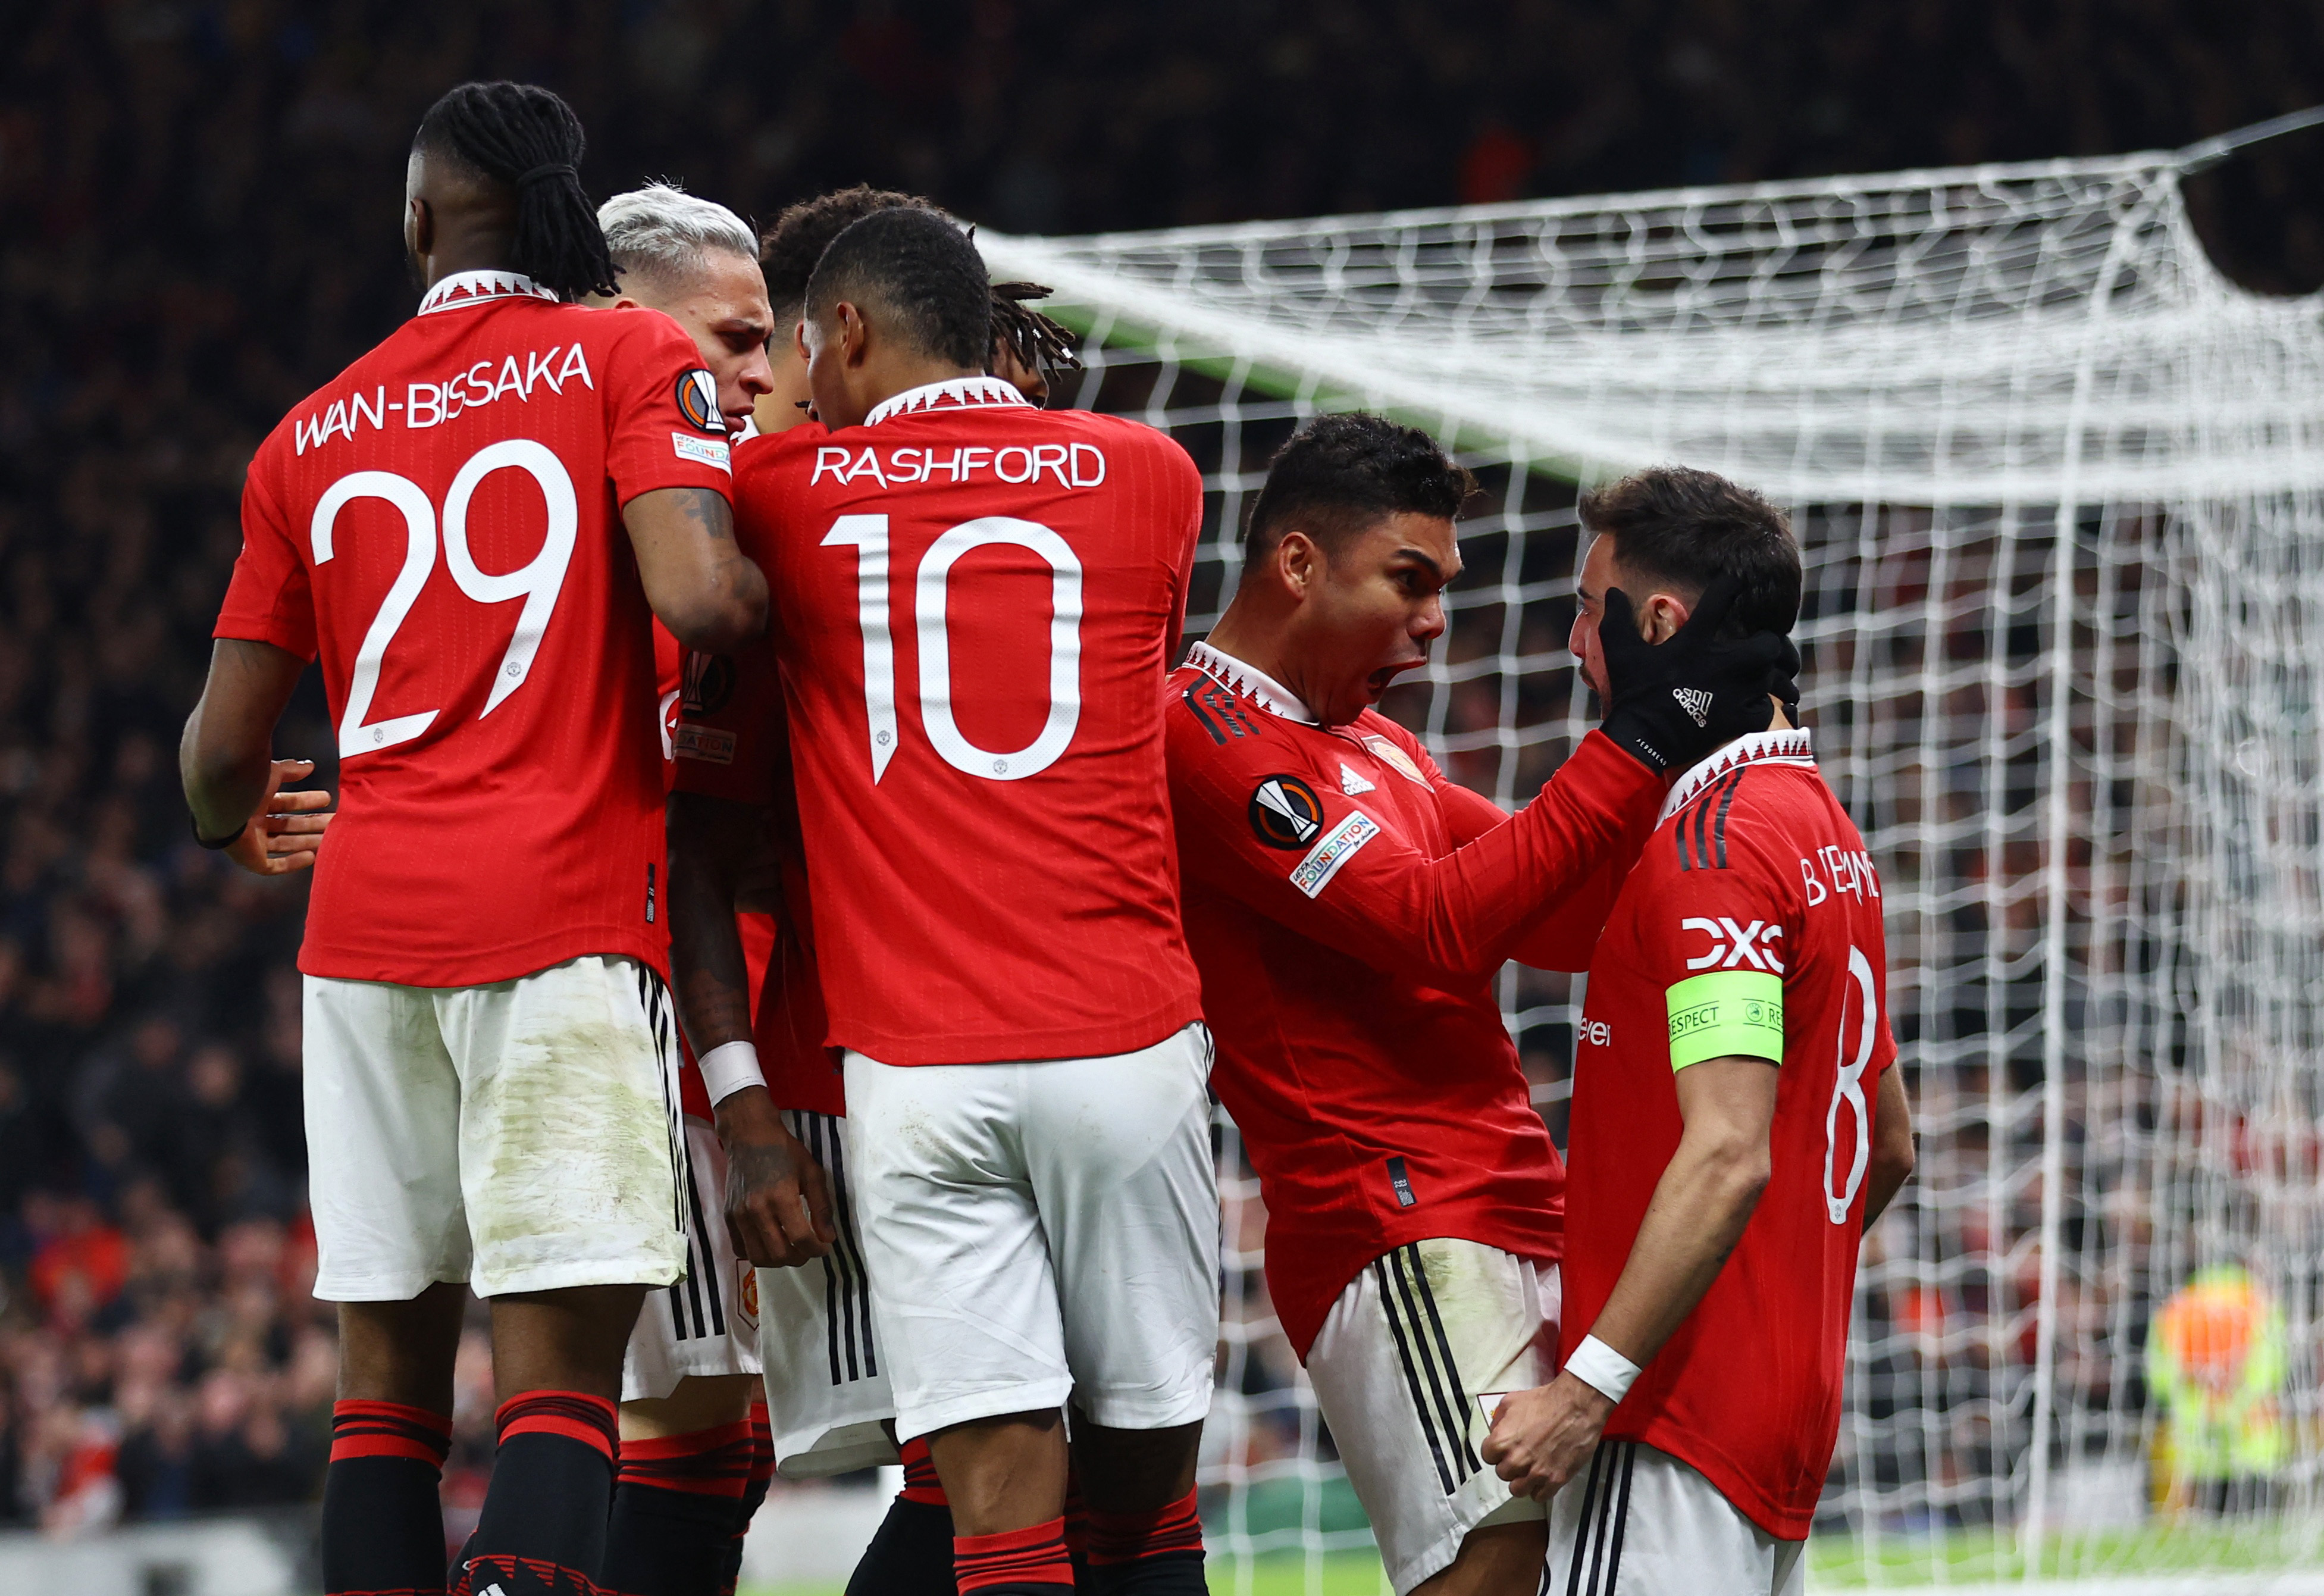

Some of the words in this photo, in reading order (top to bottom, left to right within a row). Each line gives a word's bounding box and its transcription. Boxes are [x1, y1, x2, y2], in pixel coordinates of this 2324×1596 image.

[296, 343, 594, 456] WAN-BISSAKA
[810, 443, 1105, 489] RASHFORD
[311, 439, 578, 759] 29
[819, 514, 1083, 787] 10
[1672, 688, 1706, 728] adidas
[1293, 861, 1310, 882] UEFA
[1299, 818, 1370, 890] FOUNDATION
[1824, 944, 1877, 1224] 8
